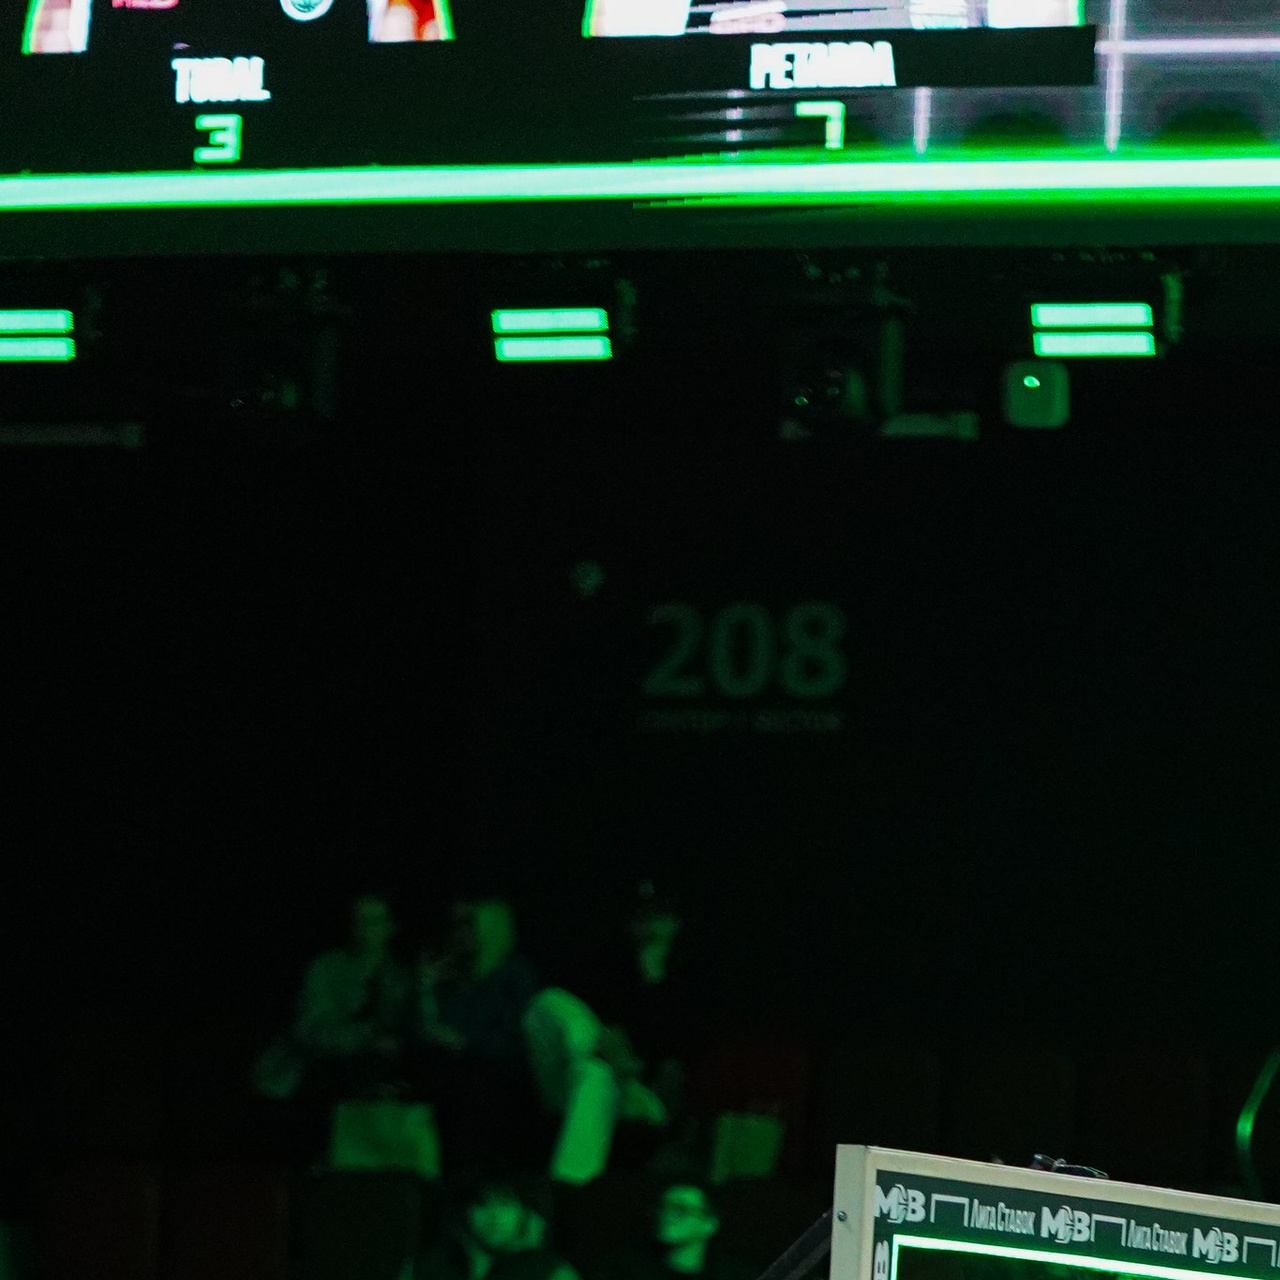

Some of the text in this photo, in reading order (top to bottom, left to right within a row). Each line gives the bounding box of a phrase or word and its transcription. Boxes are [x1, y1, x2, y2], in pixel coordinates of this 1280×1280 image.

[194, 114, 242, 163] 3
[796, 101, 845, 150] 7
[643, 604, 848, 697] 208
